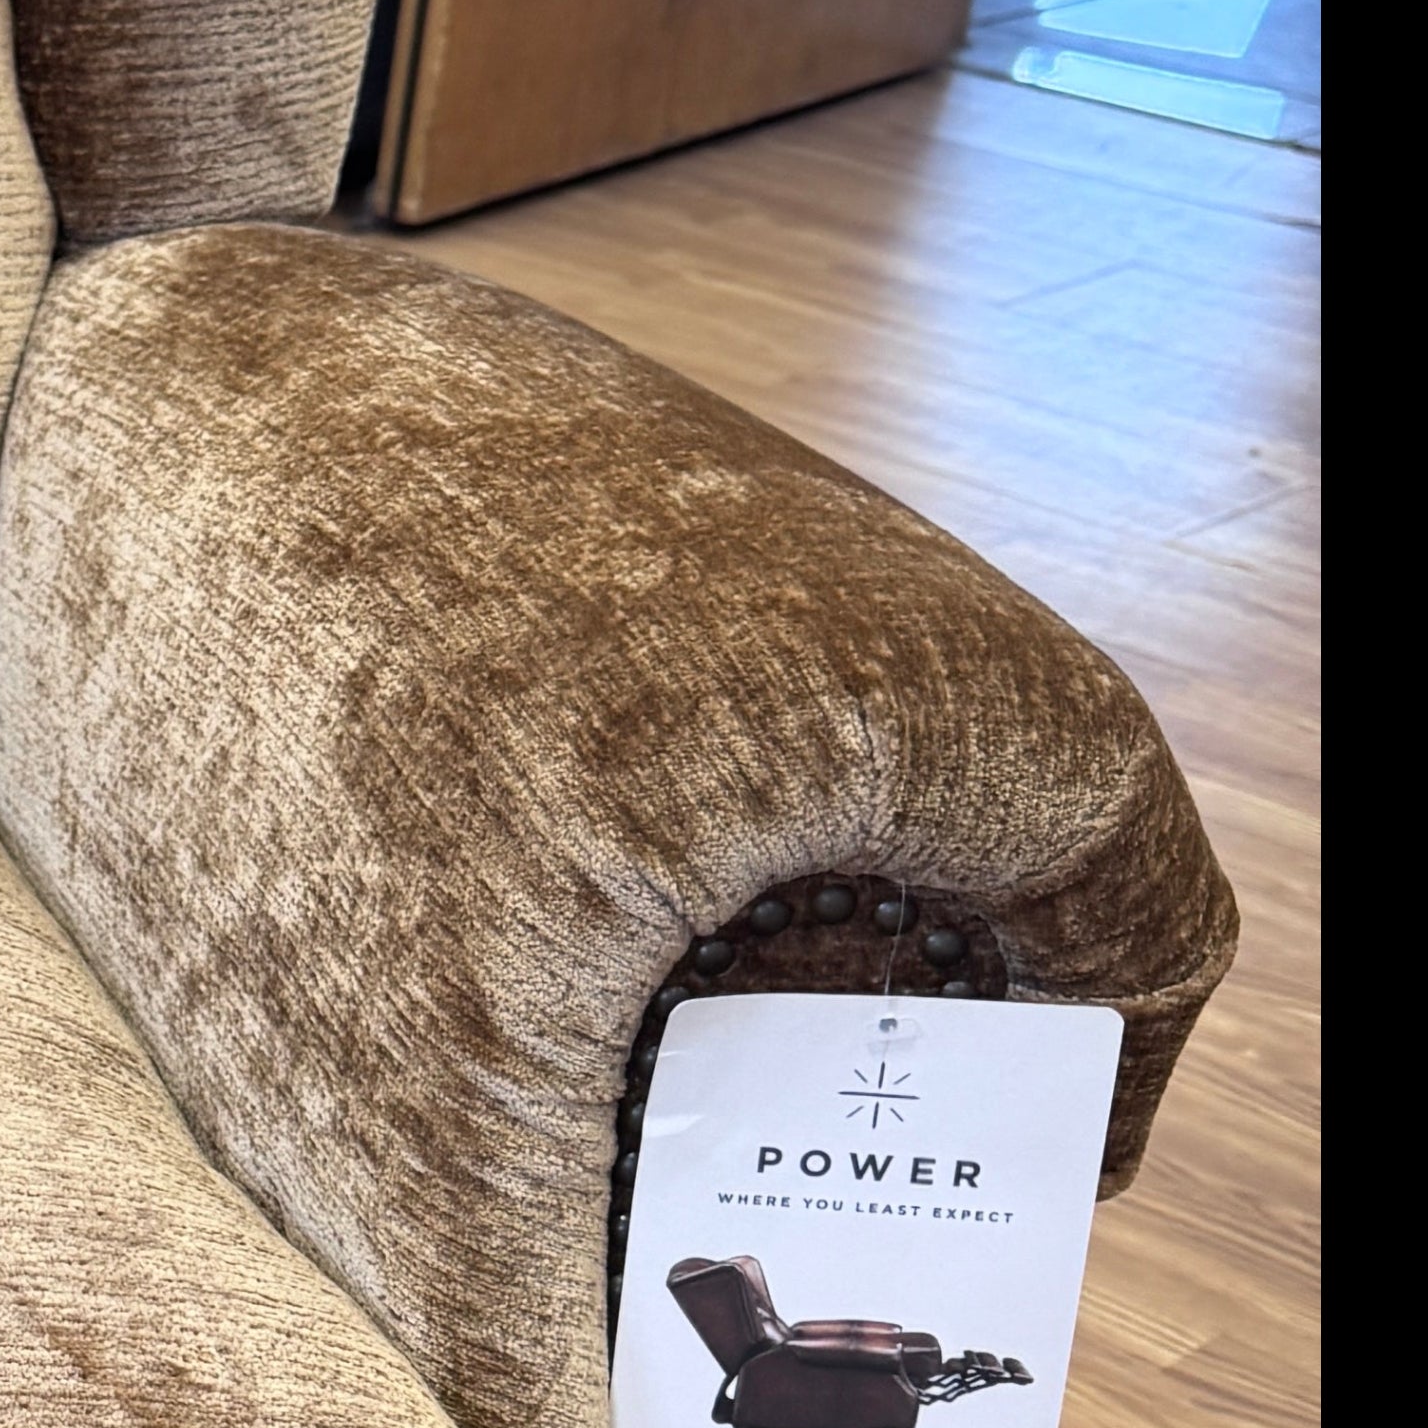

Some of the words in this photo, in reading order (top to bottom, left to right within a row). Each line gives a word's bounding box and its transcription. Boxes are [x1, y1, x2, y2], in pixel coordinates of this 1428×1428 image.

[756, 1146, 981, 1189] POWER
[717, 1192, 791, 1208] WHERE
[802, 1197, 844, 1212] YOU
[855, 1201, 921, 1217] LEAST
[932, 1207, 1014, 1224] EXPECT
